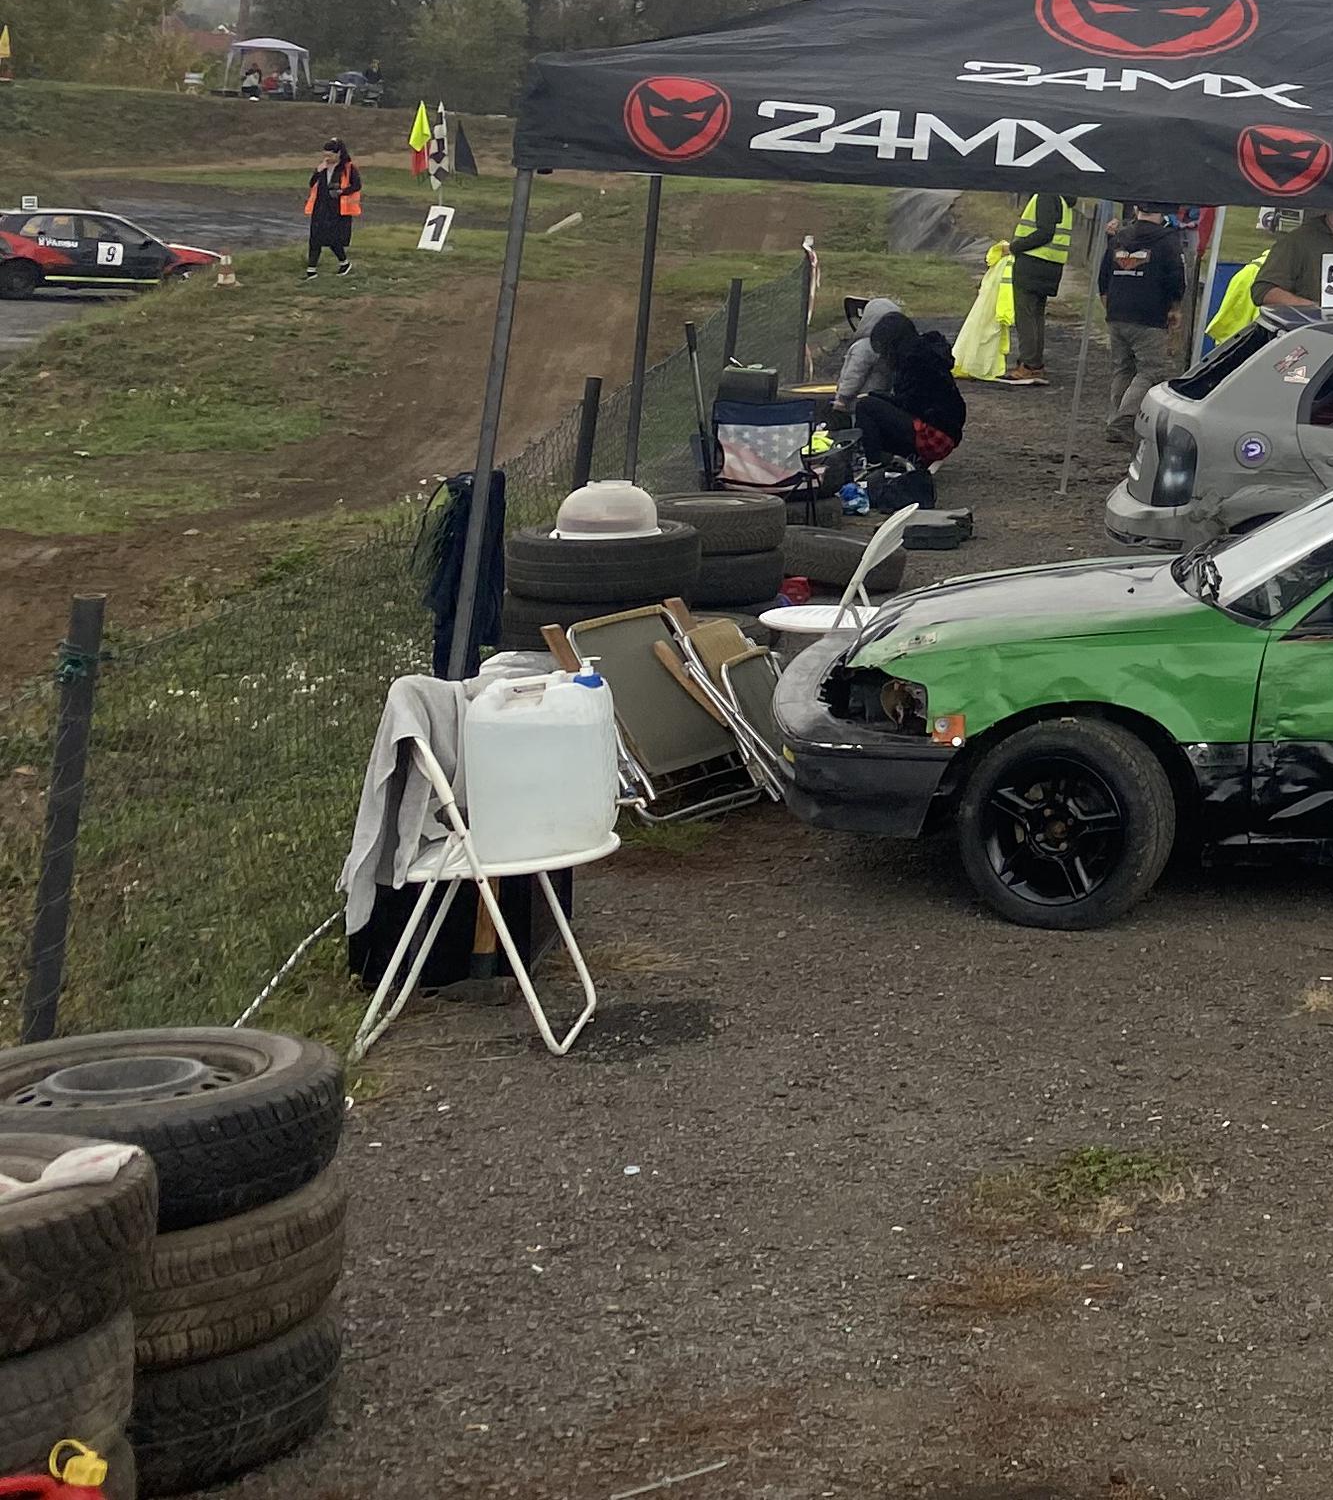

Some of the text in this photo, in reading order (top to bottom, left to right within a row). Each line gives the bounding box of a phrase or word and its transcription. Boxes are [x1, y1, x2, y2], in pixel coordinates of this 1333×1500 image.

[957, 61, 1312, 109] 24MX
[750, 101, 1105, 172] 24MX
[427, 215, 447, 242] 1
[105, 245, 117, 262] 9
